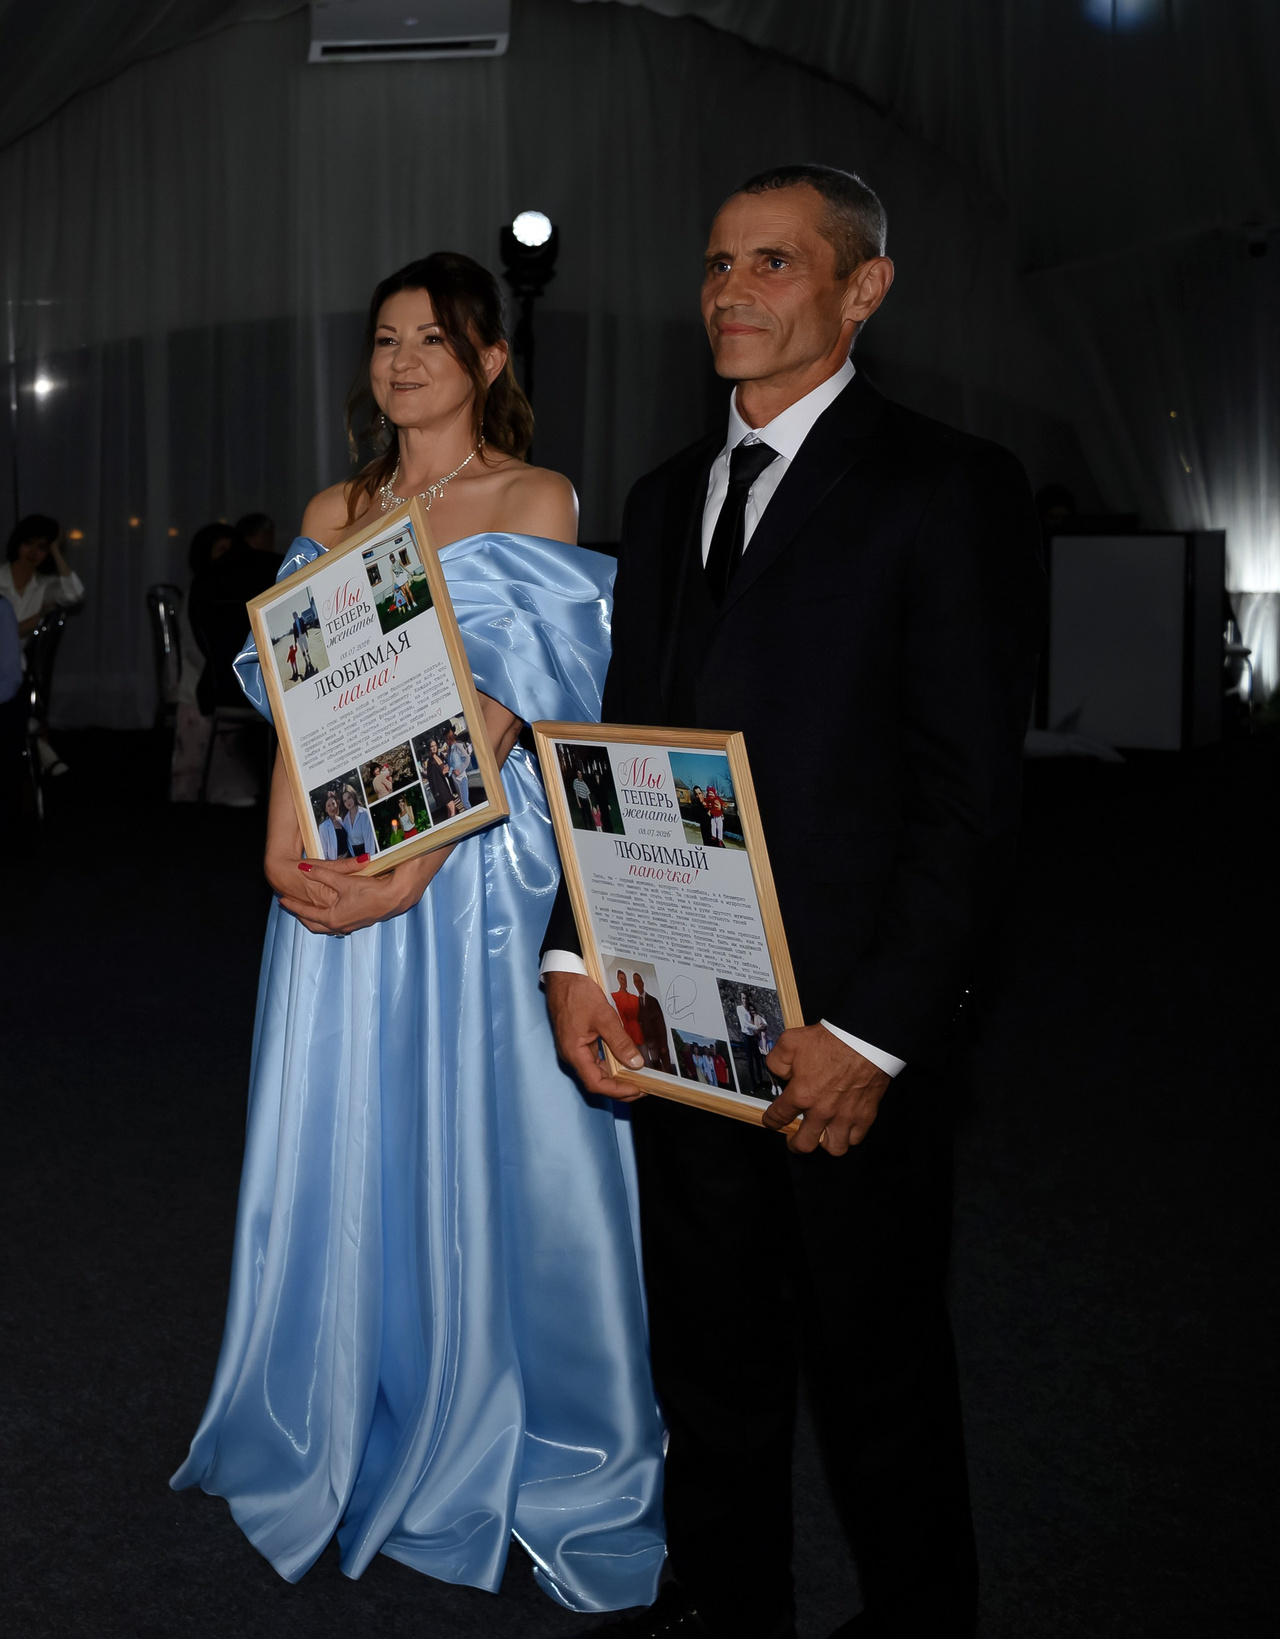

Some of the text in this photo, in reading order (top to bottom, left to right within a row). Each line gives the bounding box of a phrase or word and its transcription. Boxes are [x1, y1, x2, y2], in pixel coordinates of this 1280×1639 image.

[323, 576, 364, 621] Мы
[326, 602, 371, 634] ТЕПЕРЬ
[327, 614, 374, 648] женаты
[315, 631, 410, 698] ЛЮБИМАЯ
[333, 655, 398, 711] мама!
[618, 755, 666, 789] Мы
[621, 789, 673, 808] ТЕПЕРЬ
[623, 808, 677, 823] женаты
[615, 841, 708, 870] ЛЮБИМЫЙ
[628, 863, 700, 885] папочка!
